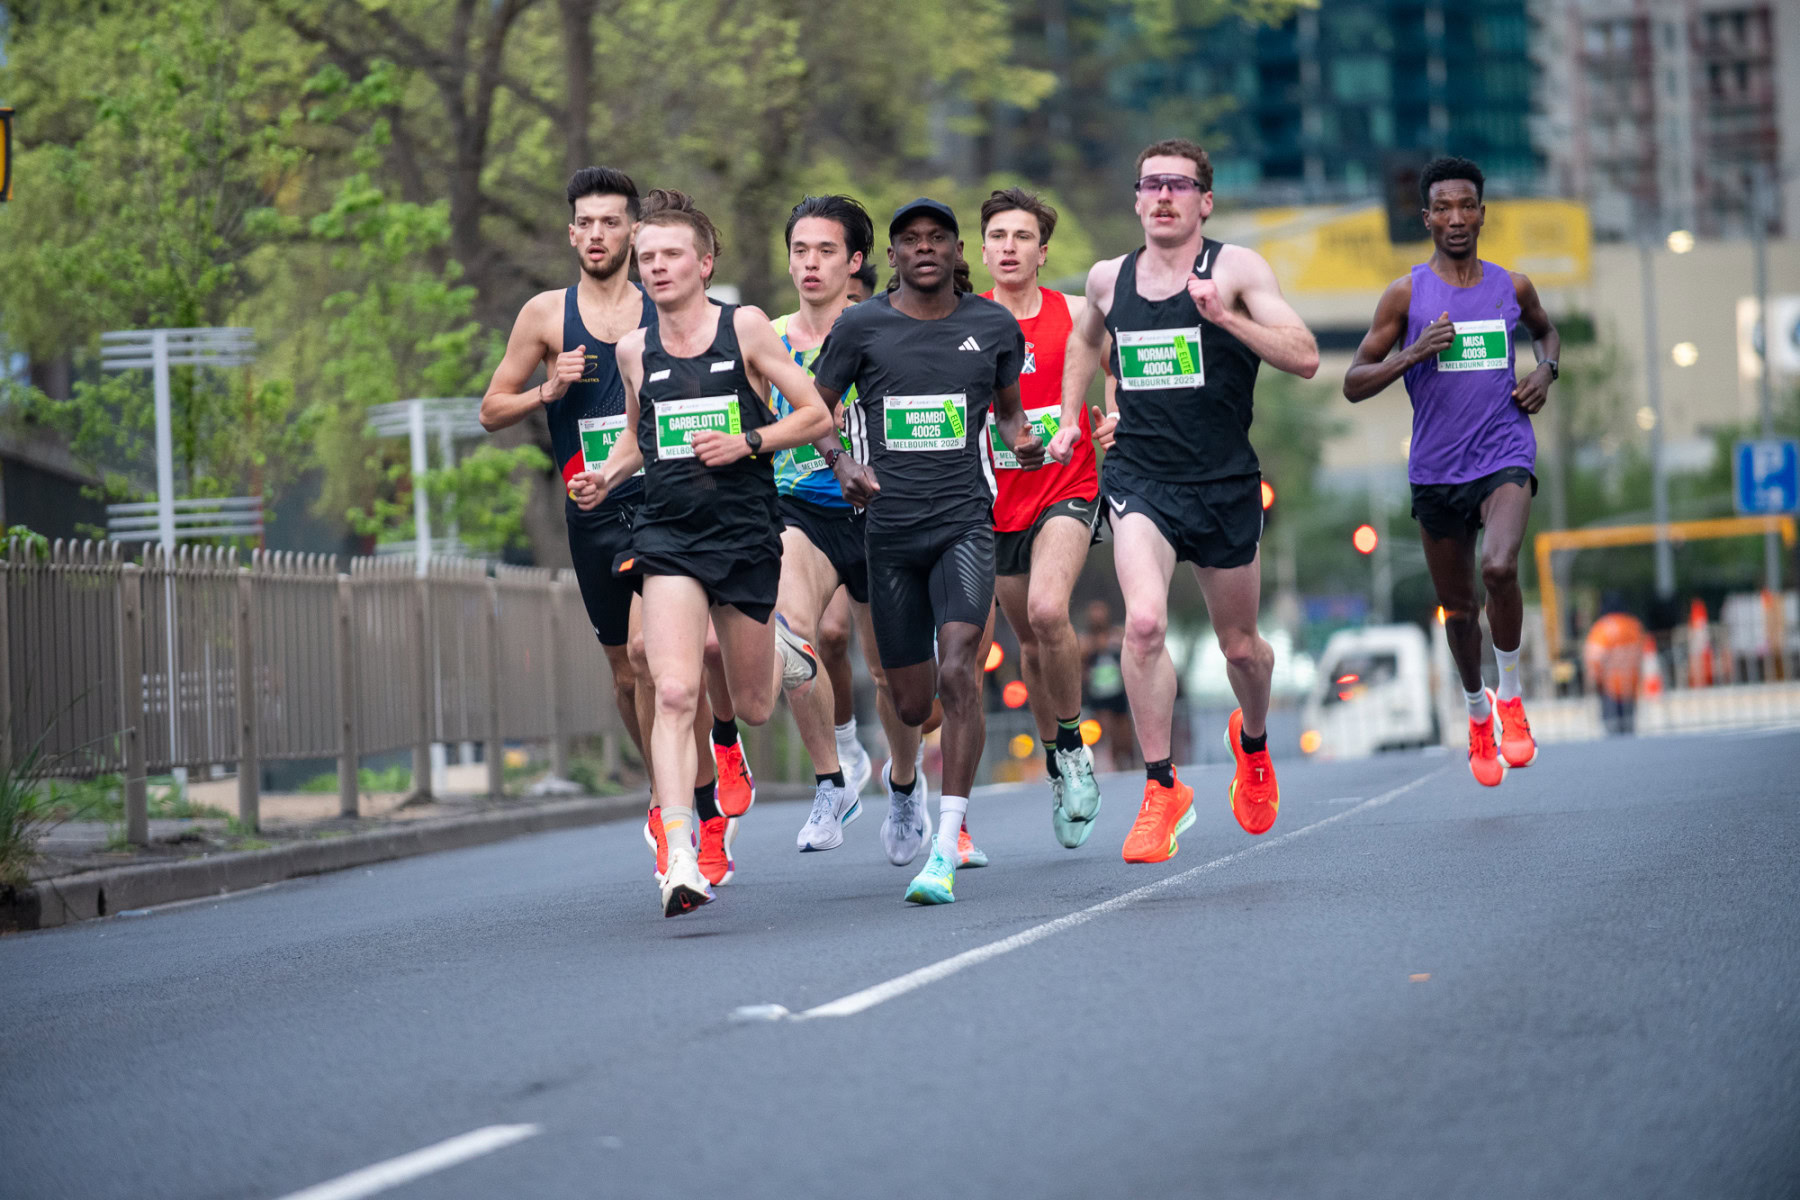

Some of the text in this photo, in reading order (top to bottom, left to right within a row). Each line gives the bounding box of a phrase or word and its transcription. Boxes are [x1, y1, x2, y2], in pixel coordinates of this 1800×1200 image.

[1462, 335, 1485, 347] MUSA
[1137, 347, 1177, 362] NORMAN
[1461, 347, 1487, 359] 40036
[1142, 361, 1174, 376] 40004
[1179, 351, 1193, 375] ELITE
[1445, 361, 1485, 369] MELBOURNE
[1128, 376, 1195, 388] MELBOURNE 2025
[668, 412, 726, 431] GARBELOTTO
[905, 411, 946, 425] MBAMBO
[731, 418, 740, 435] ELIT
[911, 425, 941, 438] 40025
[950, 414, 964, 437] ELITE
[893, 439, 960, 449] MELBOURNE 2025
[665, 447, 695, 457] MELBOU
[801, 459, 825, 469] MELBO
